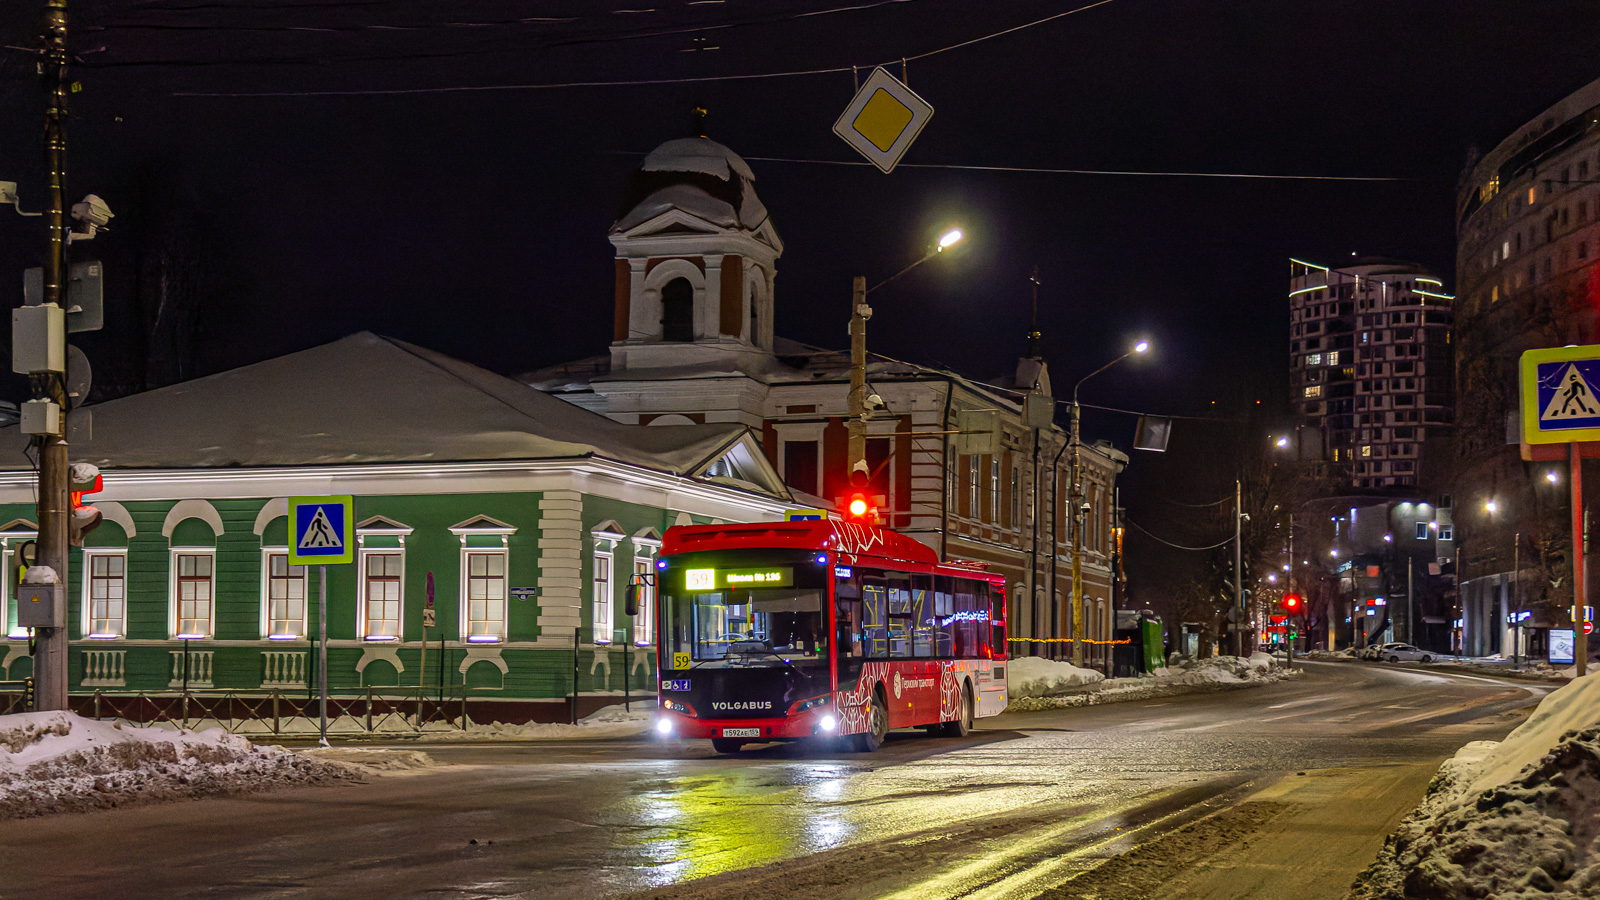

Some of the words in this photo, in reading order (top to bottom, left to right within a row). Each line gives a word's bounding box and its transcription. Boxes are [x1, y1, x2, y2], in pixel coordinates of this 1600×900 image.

[691, 573, 708, 585] 59
[675, 655, 689, 668] 59
[712, 701, 772, 710] VOLGABUS
